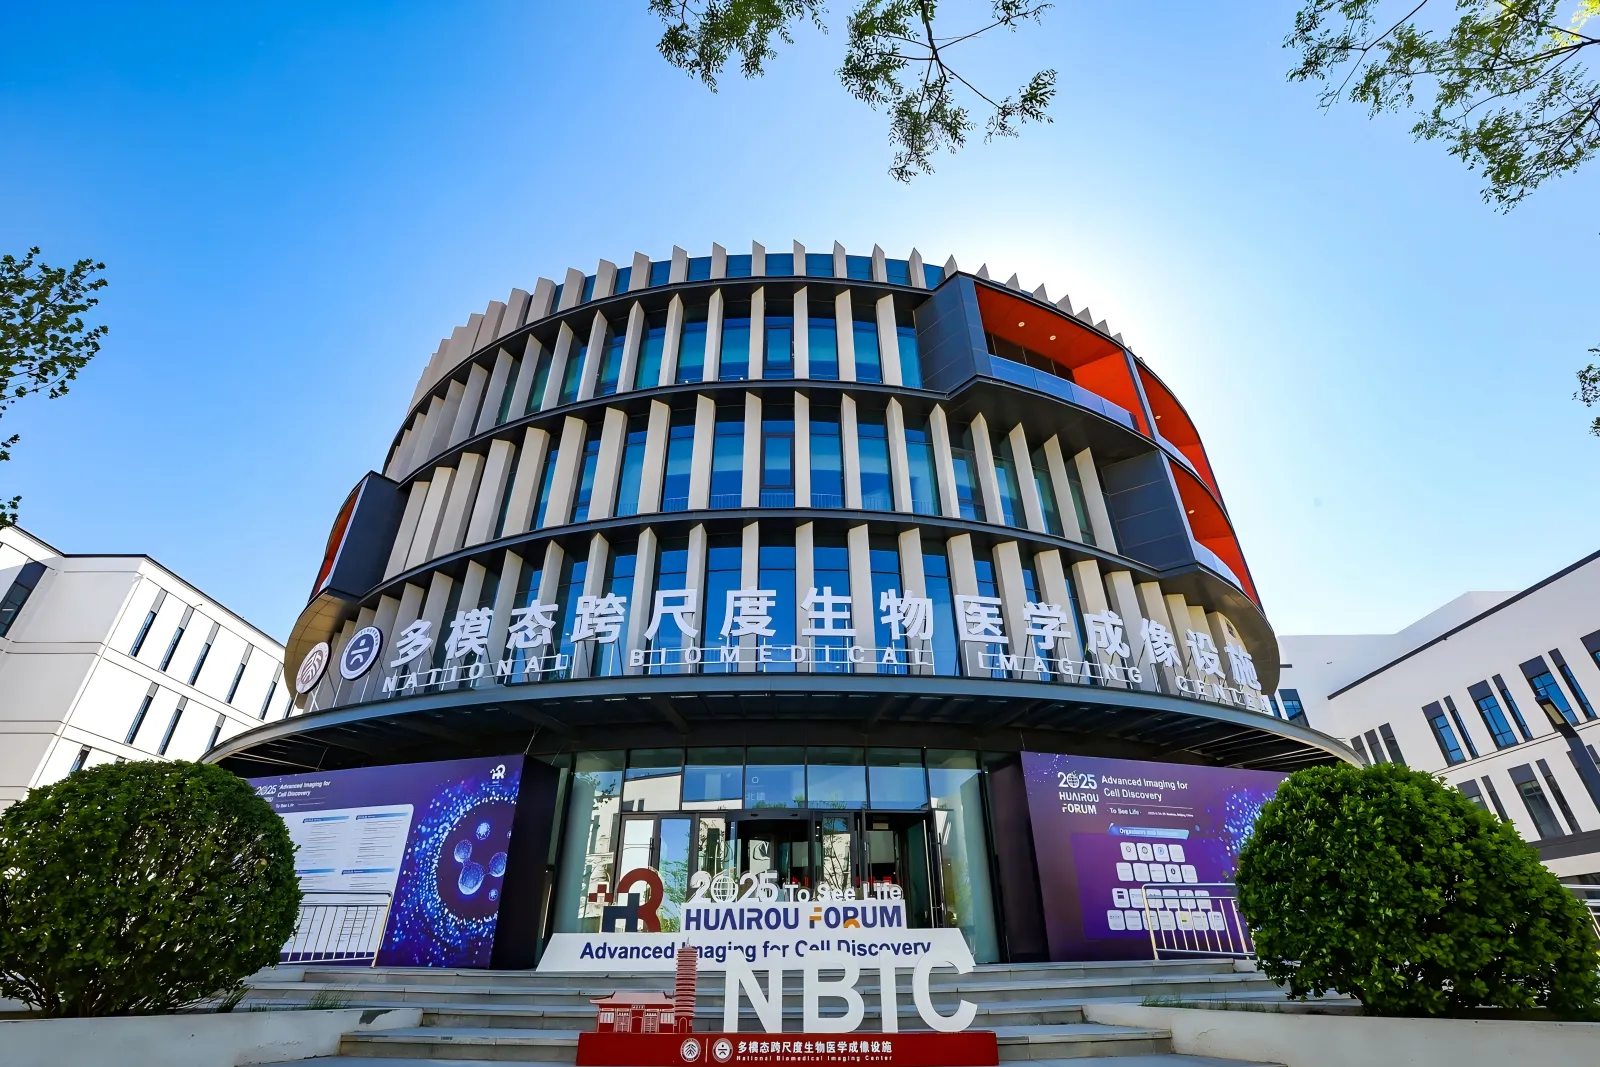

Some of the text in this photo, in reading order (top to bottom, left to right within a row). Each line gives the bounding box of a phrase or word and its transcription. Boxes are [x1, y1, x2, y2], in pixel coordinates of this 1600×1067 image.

[390, 586, 1261, 690] 多模态跨尺度生物医学成像设施
[382, 654, 568, 693] NATIONAL
[630, 645, 931, 667] BIOMEDICAL
[978, 652, 1142, 684] IMAGING
[1057, 771, 1188, 790] 2025 Advanced Imaging for
[1103, 787, 1162, 801] Cell Discovery
[1062, 803, 1097, 815] FORUM
[689, 869, 779, 902] 2025
[784, 882, 903, 902] To See Life
[809, 905, 902, 929] FORUM
[580, 942, 675, 959] Advanced
[723, 948, 978, 1034] NBIC
[738, 1041, 892, 1054] 多模态跨尺度生物医学成像设施
[827, 1055, 861, 1063] Imaging
